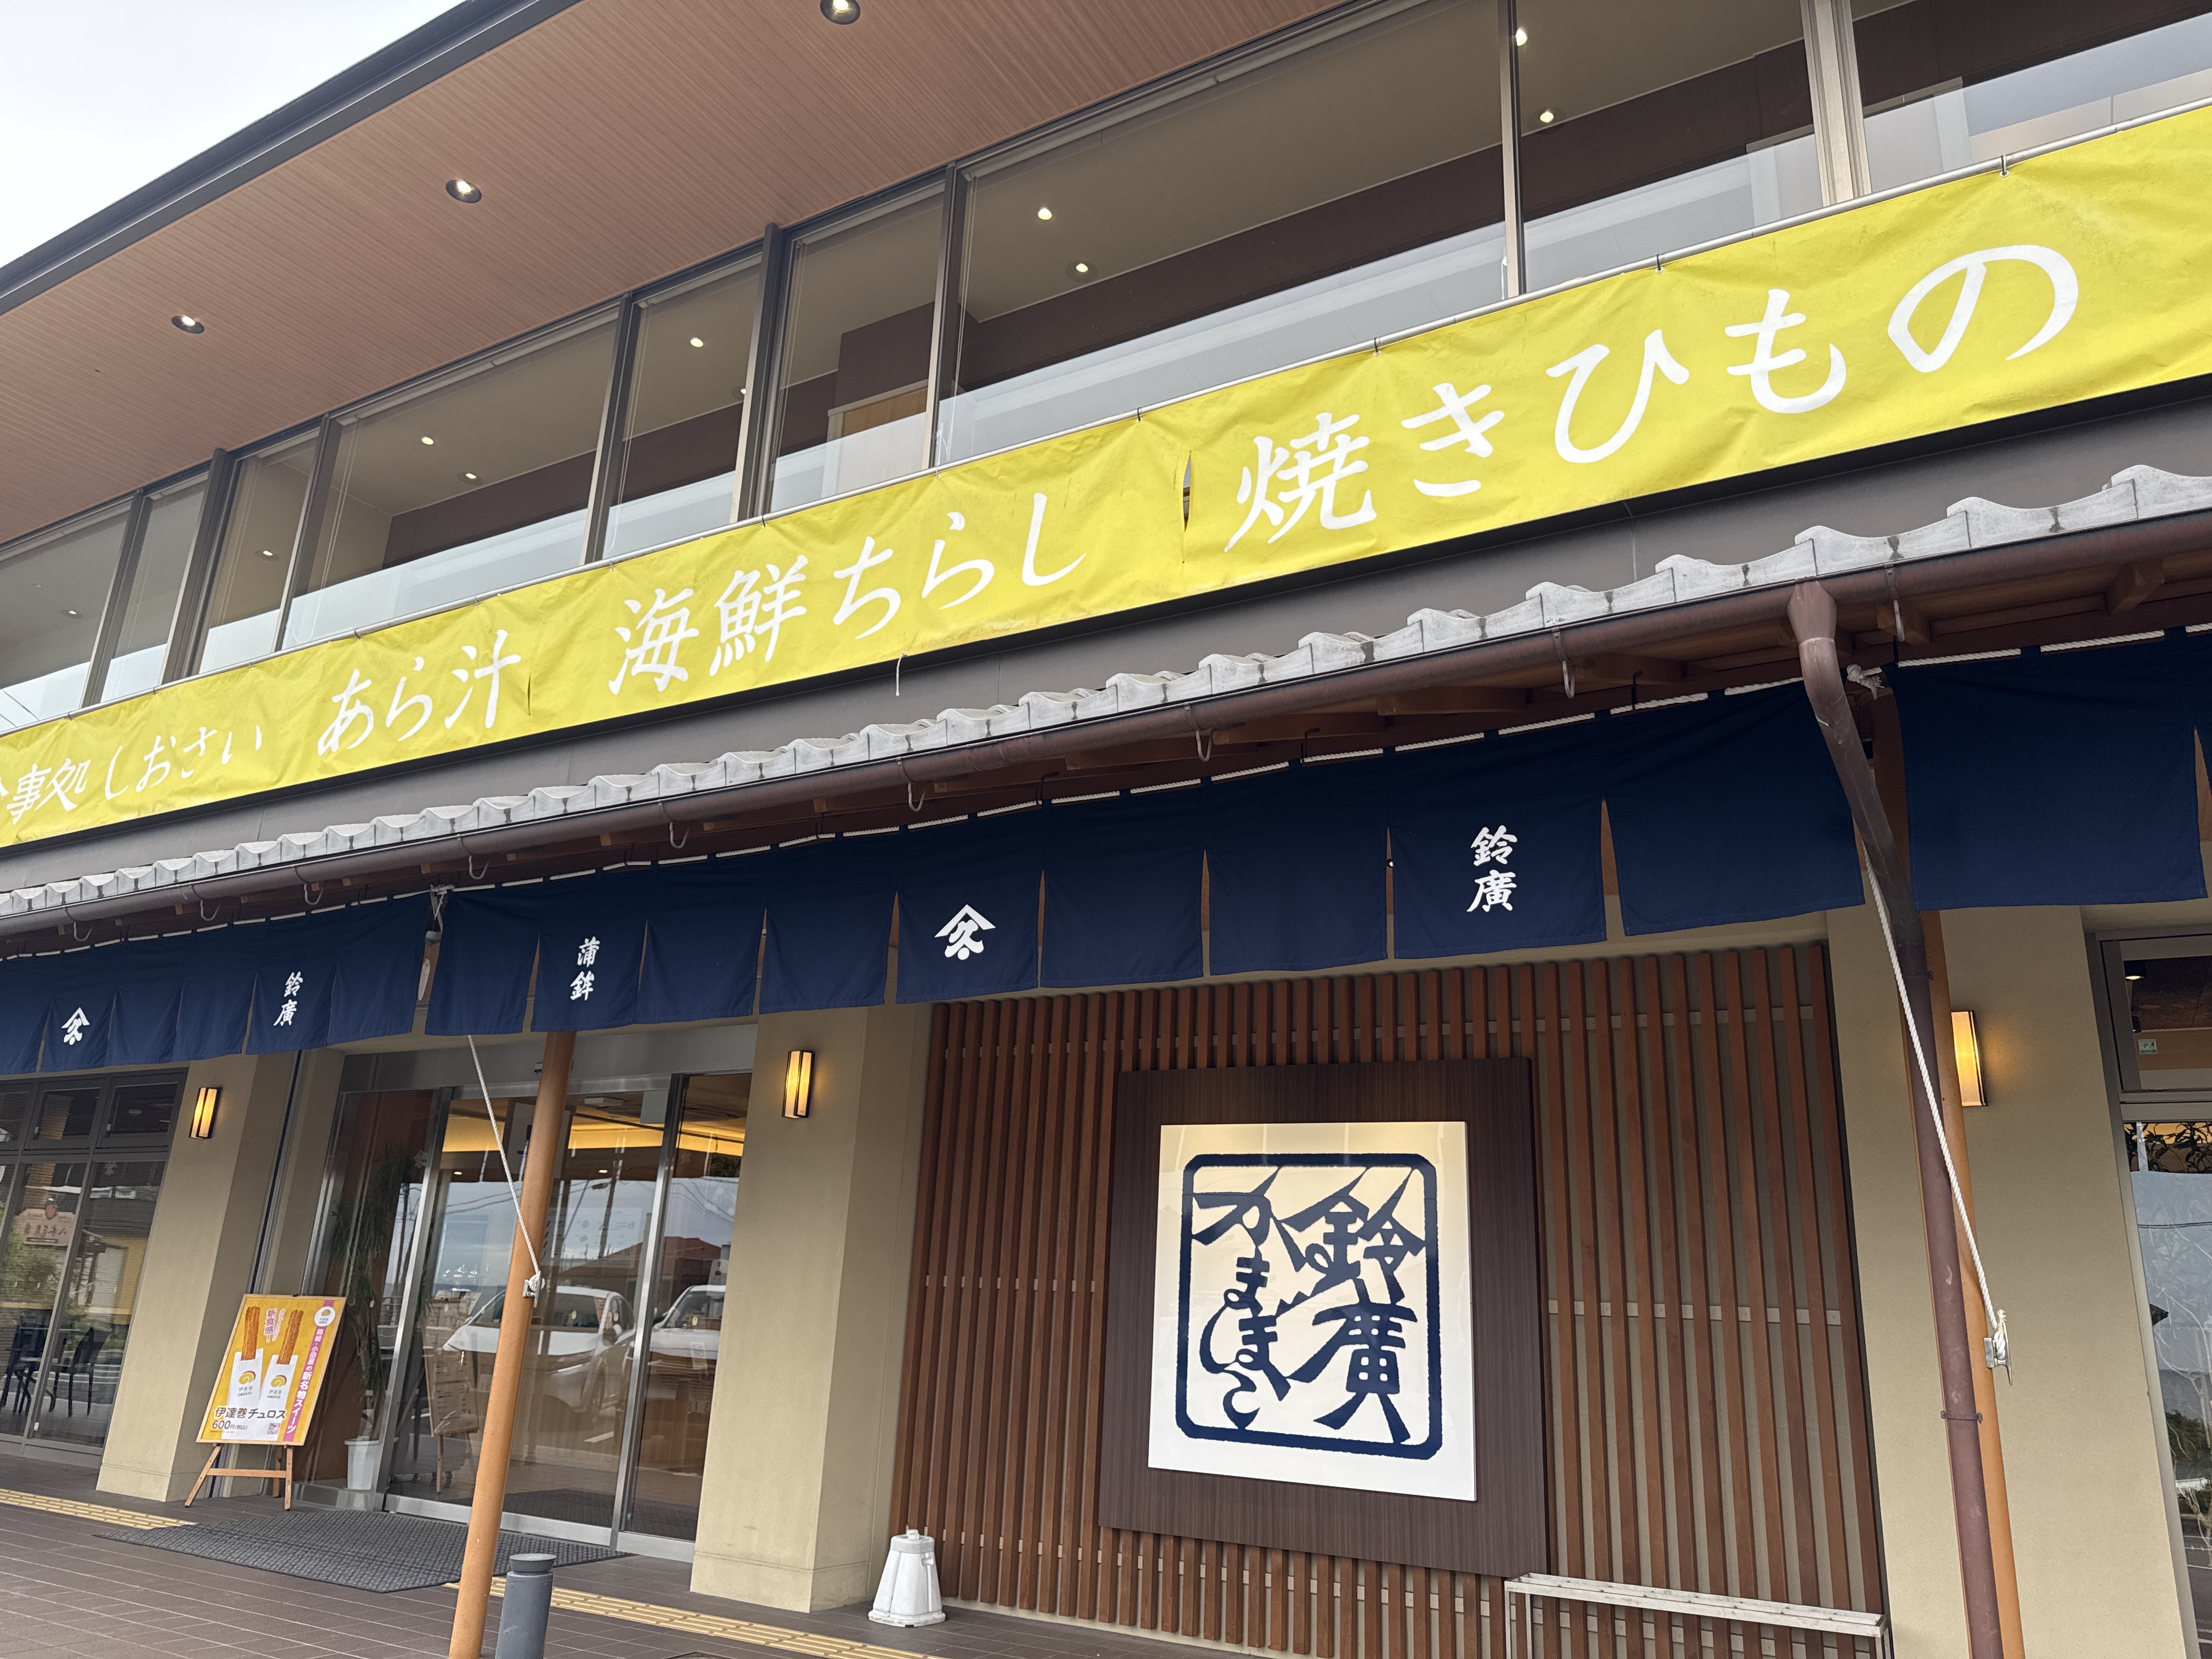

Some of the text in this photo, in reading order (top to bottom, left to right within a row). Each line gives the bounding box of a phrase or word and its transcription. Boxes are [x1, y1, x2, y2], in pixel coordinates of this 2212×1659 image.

[317, 629, 521, 755] あら汁
[608, 493, 1086, 695] 海鮮ちらし
[1224, 244, 2079, 552] 焼きひもの
[1466, 825, 1517, 912] 鈴廣
[273, 971, 303, 1026] 鈴廣
[569, 936, 600, 1001] 蒲鉾
[215, 1407, 286, 1419] 伊達巻チュロス
